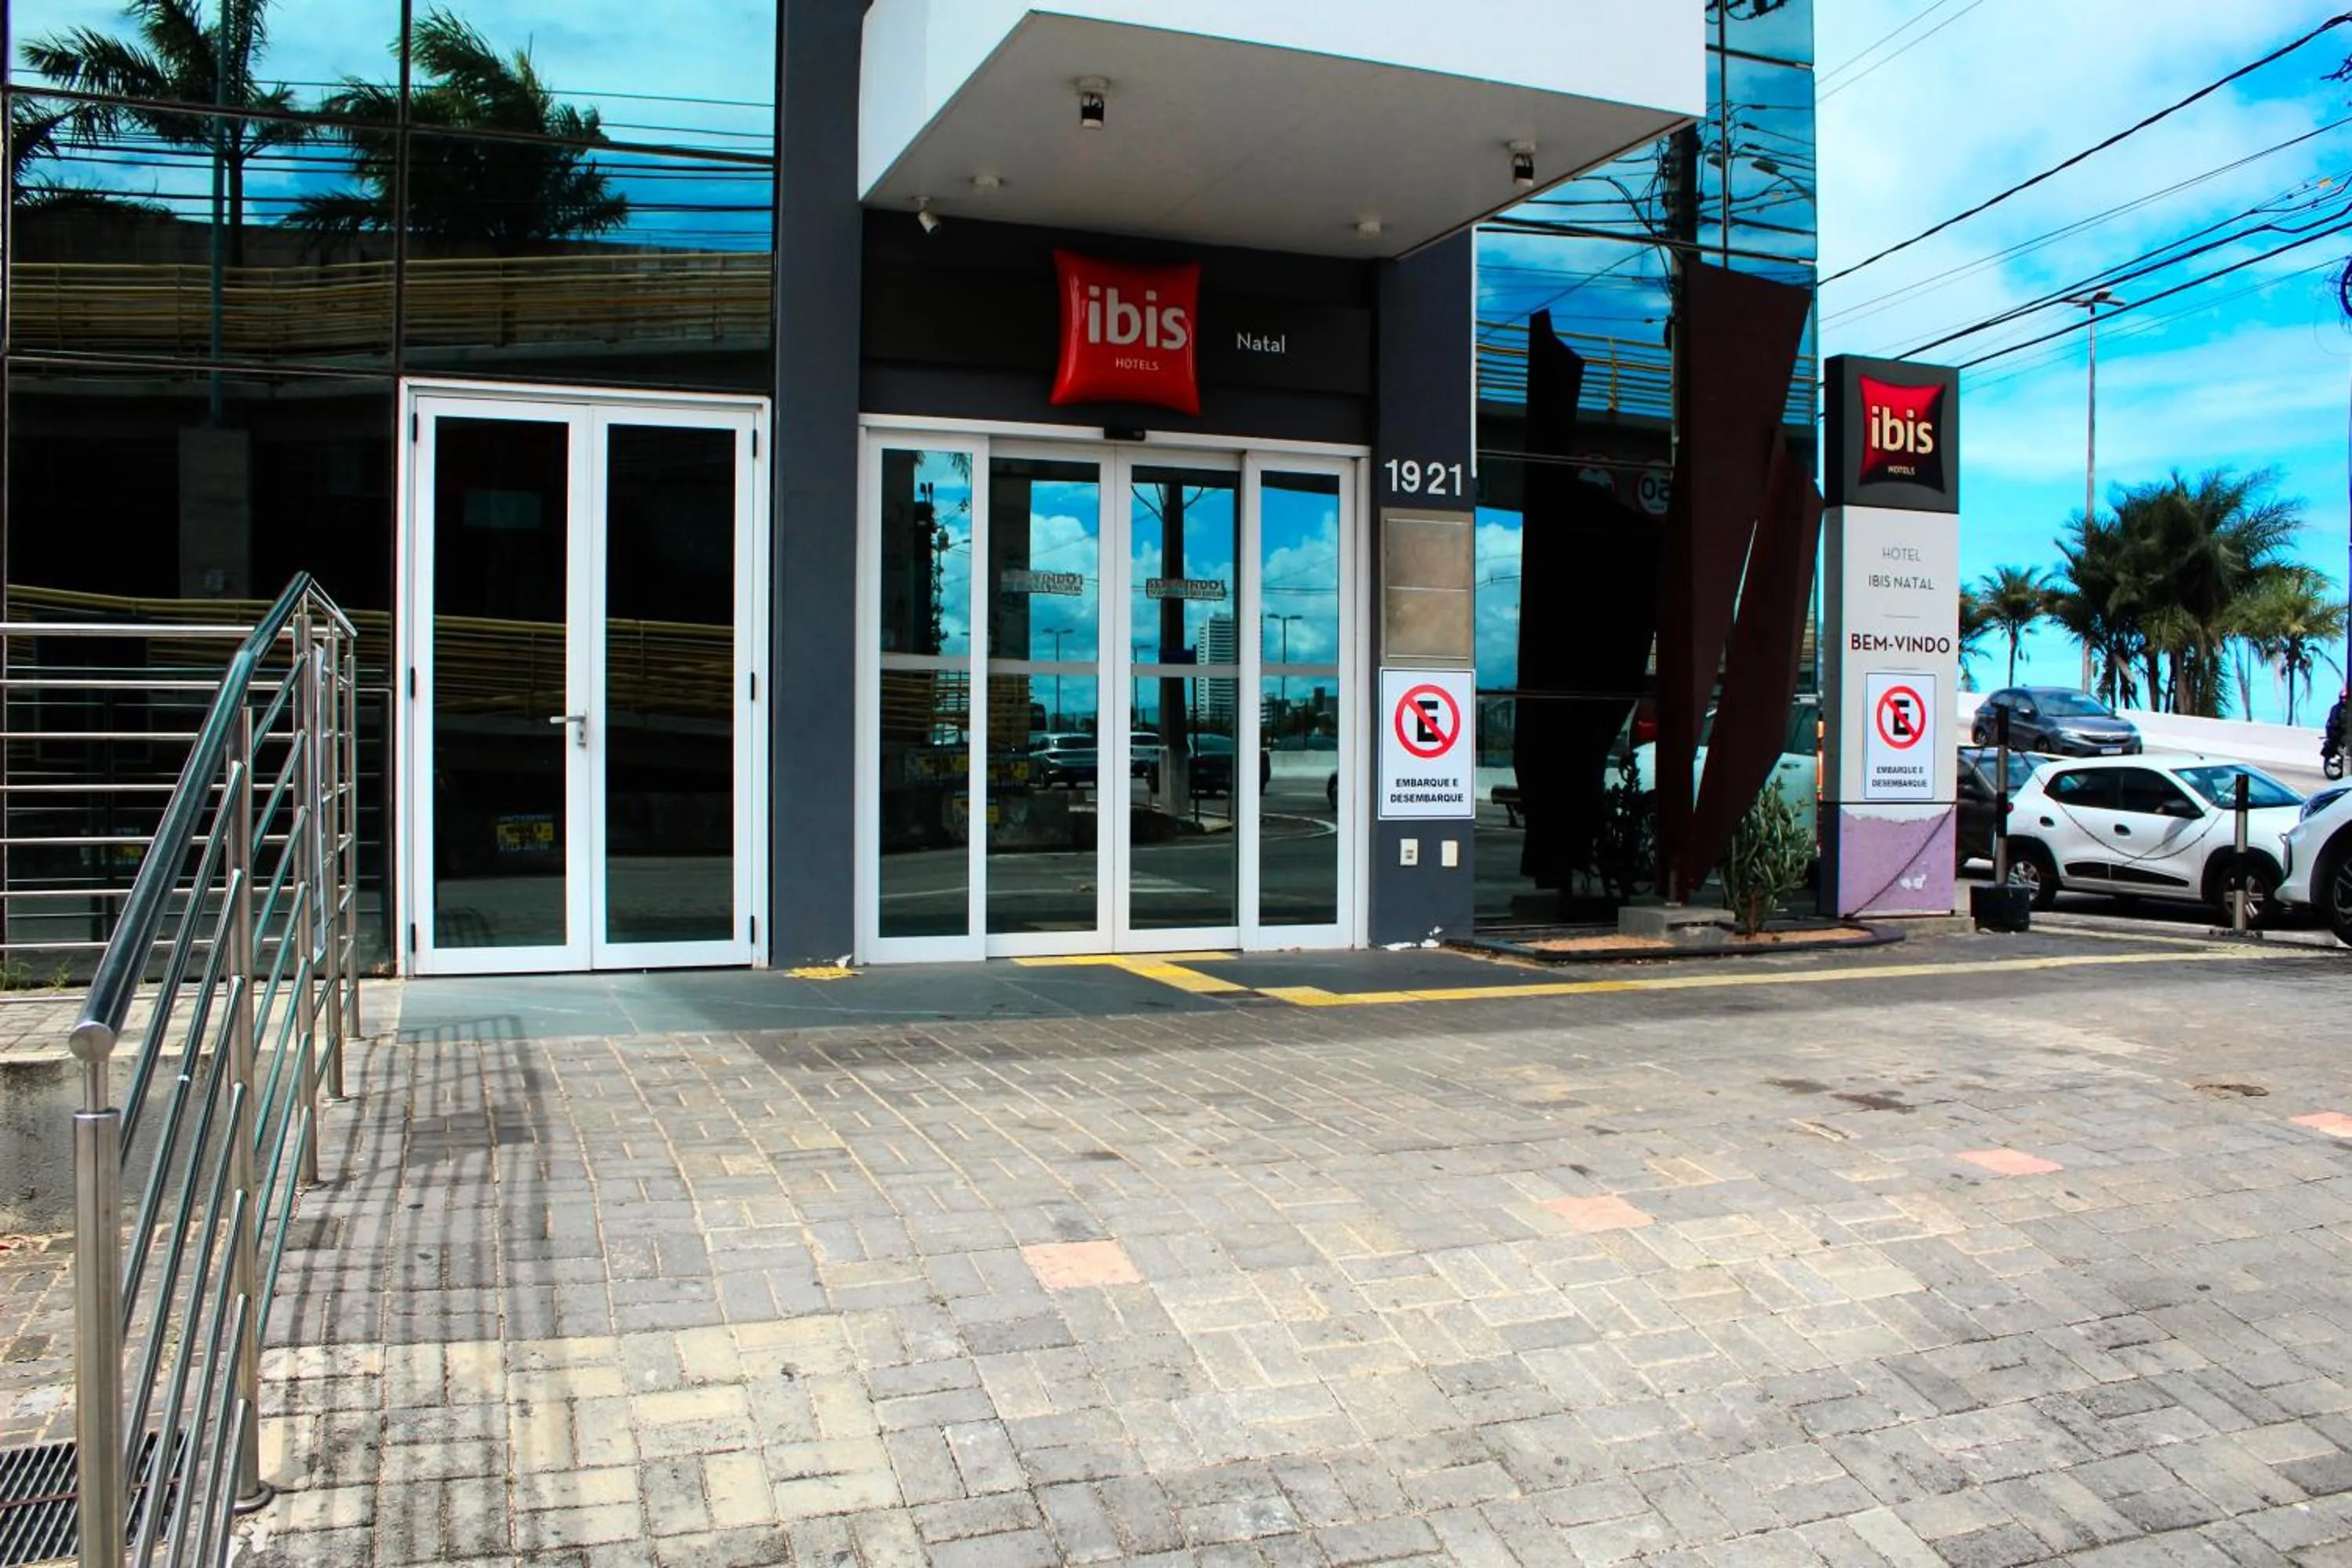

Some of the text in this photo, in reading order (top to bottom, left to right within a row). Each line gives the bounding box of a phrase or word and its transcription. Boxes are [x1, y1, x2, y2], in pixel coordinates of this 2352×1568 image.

[1087, 285, 1187, 350] ibis
[1236, 332, 1285, 353] Natal
[1116, 357, 1159, 370] HOTELS
[1871, 405, 1933, 453] ibis
[1385, 459, 1461, 495] 1921
[1887, 465, 1915, 475] HOTELS
[1882, 547, 1921, 561] HOTEL
[1868, 574, 1934, 590] IBIS NATAL
[1851, 633, 1950, 653] BEM-VINDO
[1396, 778, 1459, 787] EMBARQUE E
[1390, 793, 1464, 803] DESEMBARQUE
